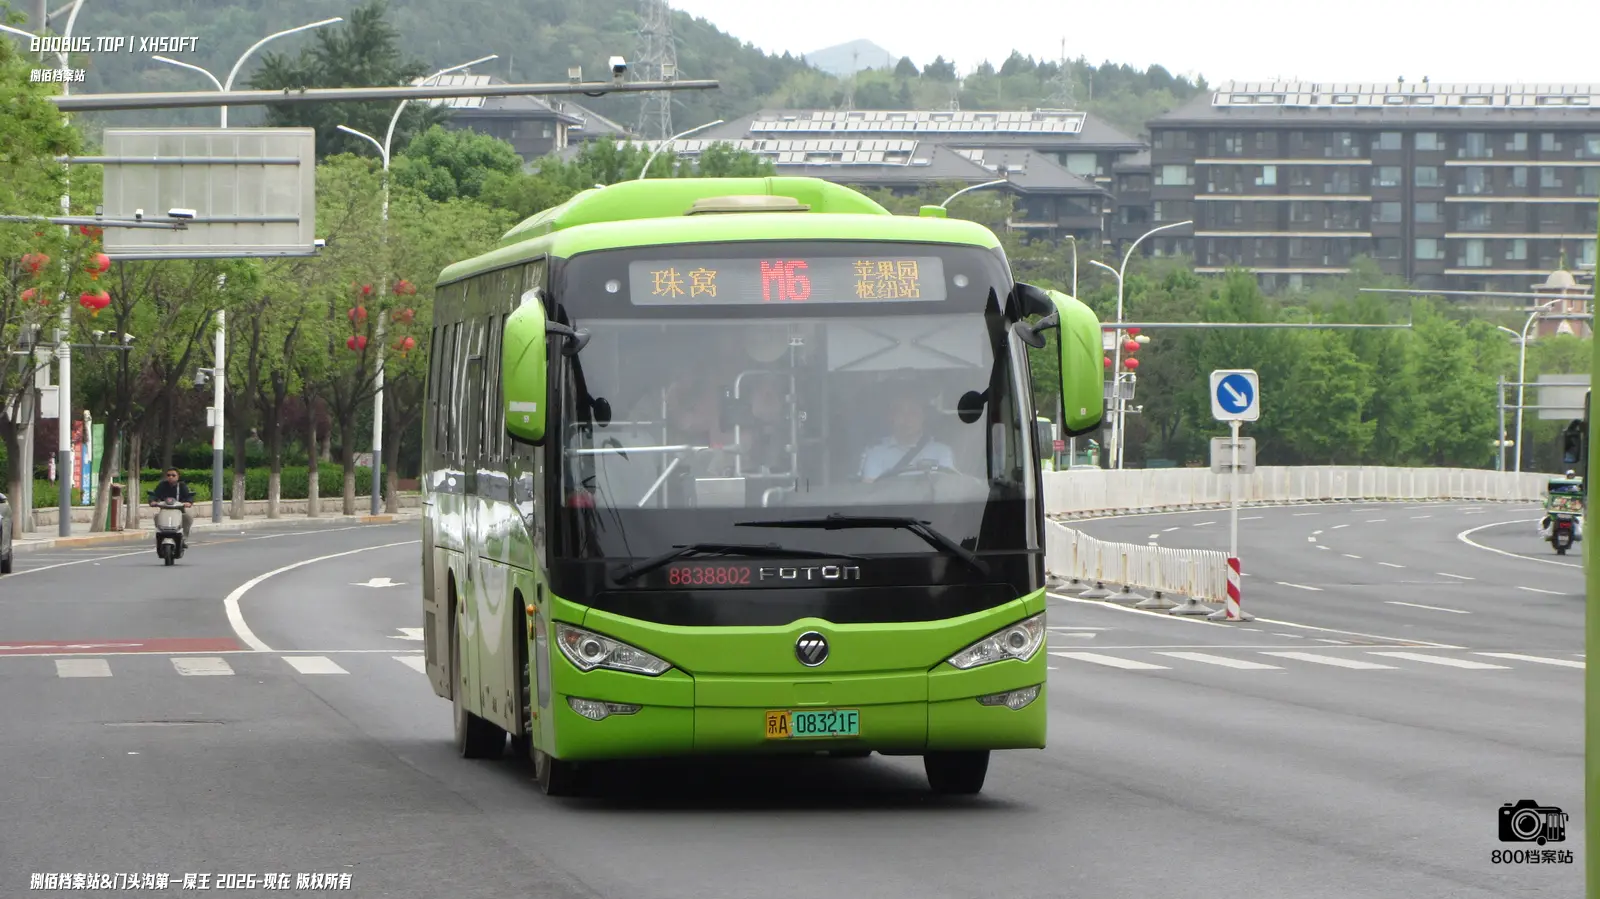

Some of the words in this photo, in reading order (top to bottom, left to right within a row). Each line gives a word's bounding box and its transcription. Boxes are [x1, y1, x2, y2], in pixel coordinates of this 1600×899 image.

[852, 260, 919, 280] 苹果园
[650, 266, 717, 299] 珠窝
[760, 260, 812, 302] M6
[854, 279, 921, 299] 枢纽站
[669, 566, 751, 585] 8838802
[759, 564, 861, 581] FOTON
